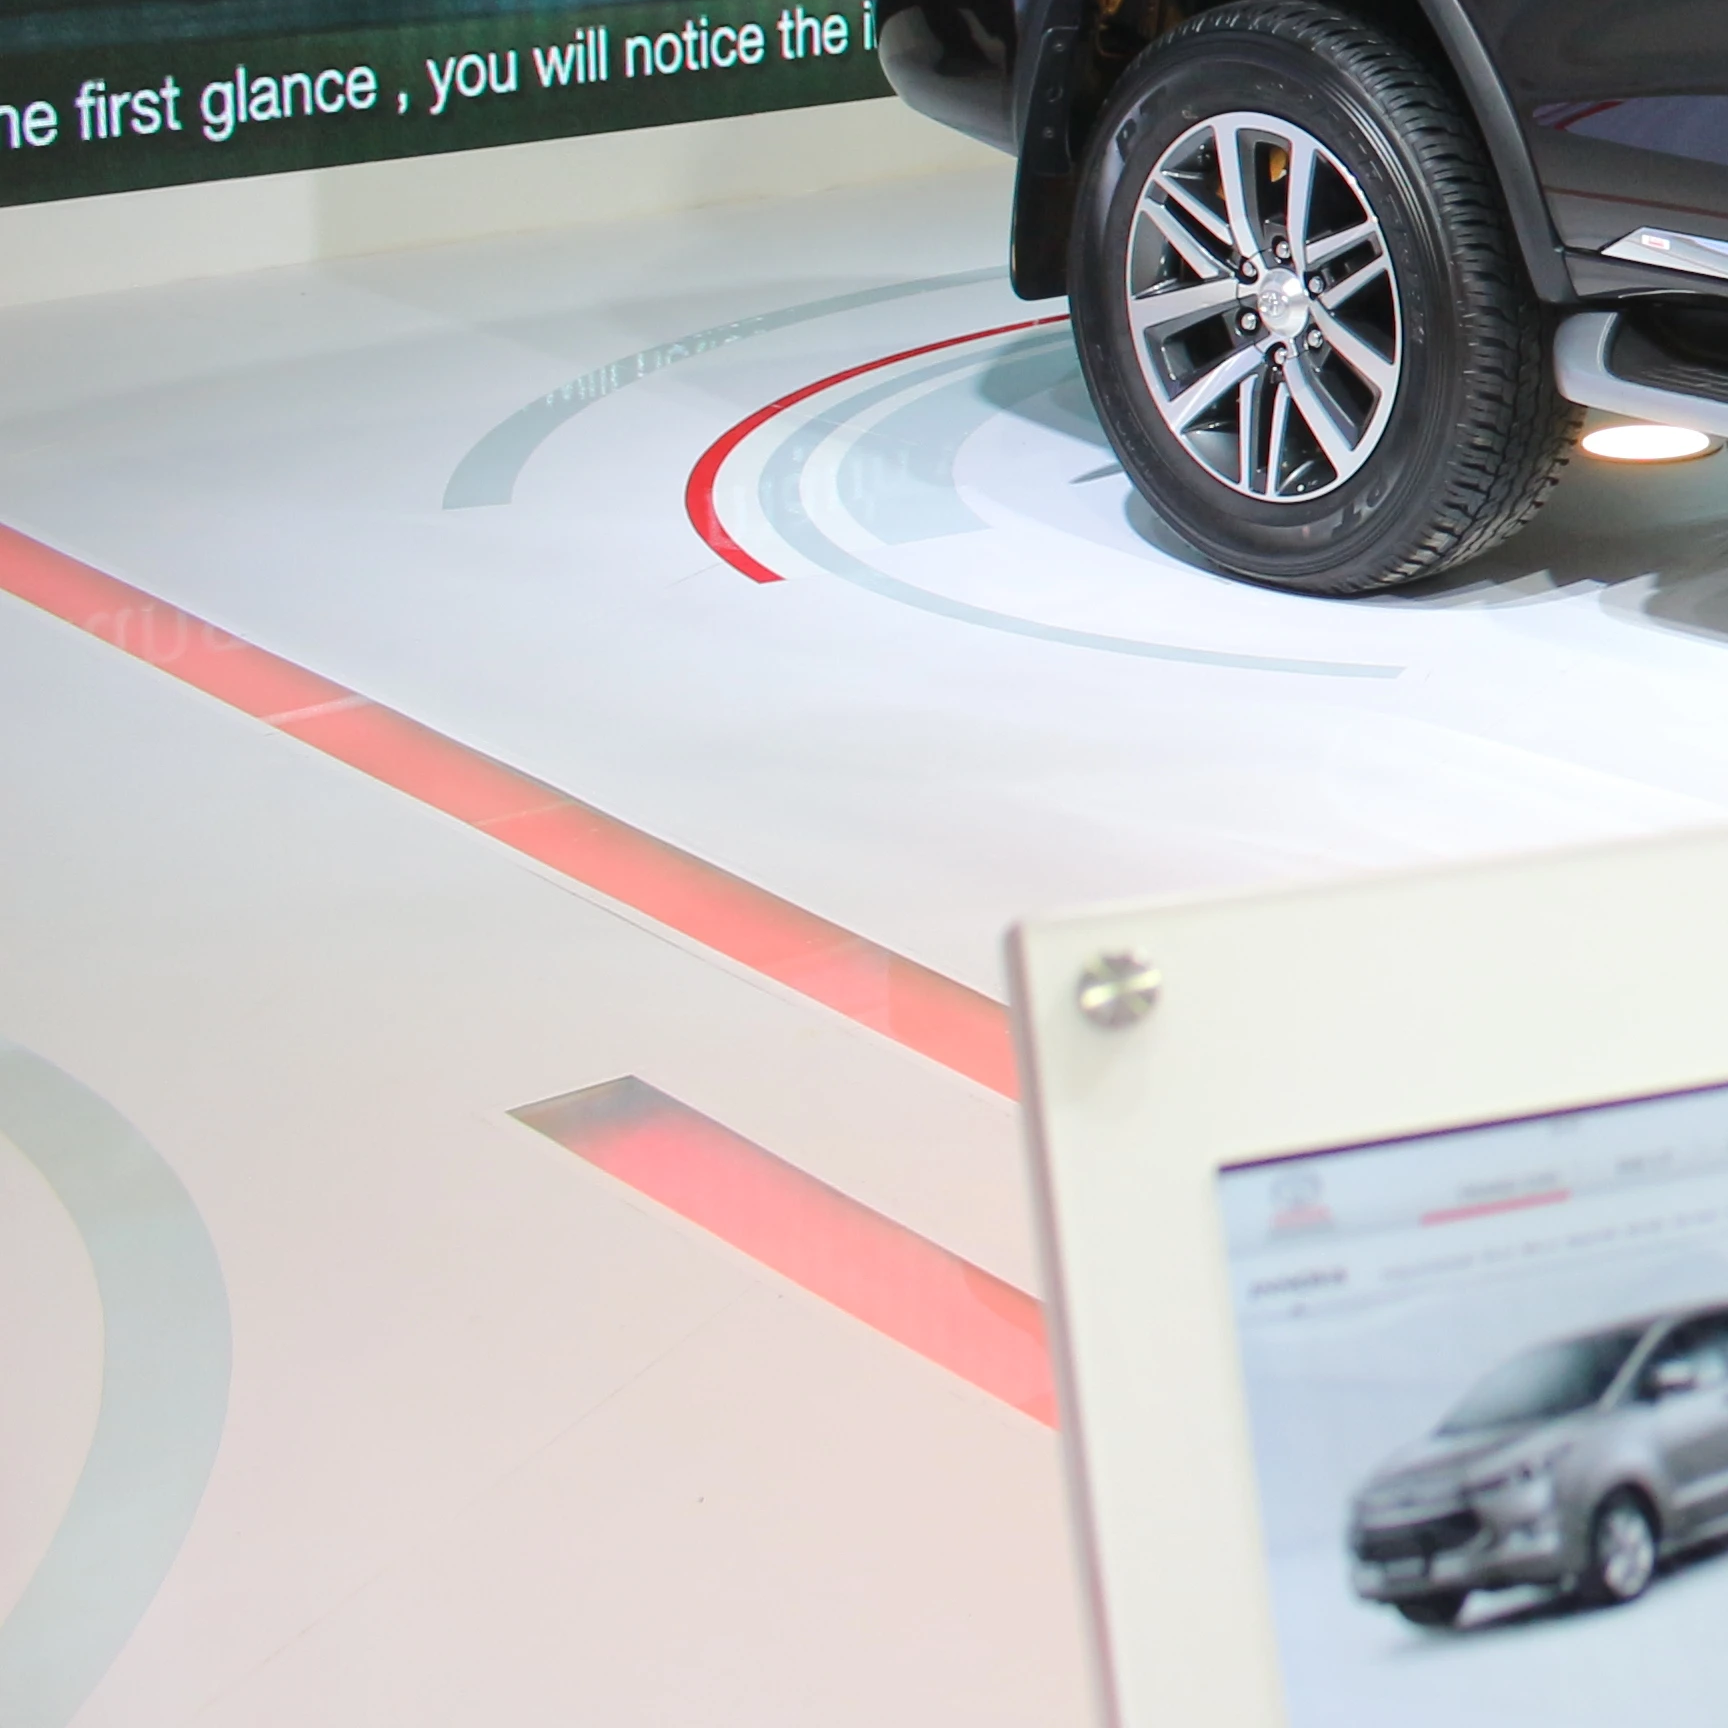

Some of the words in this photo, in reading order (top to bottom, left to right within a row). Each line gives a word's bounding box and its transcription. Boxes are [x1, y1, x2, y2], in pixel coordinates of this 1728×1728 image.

[75, 76, 182, 140] first
[201, 64, 377, 142] glance
[426, 49, 518, 114] you
[533, 25, 608, 88] will
[625, 15, 764, 78] notice
[777, 5, 849, 60] the
